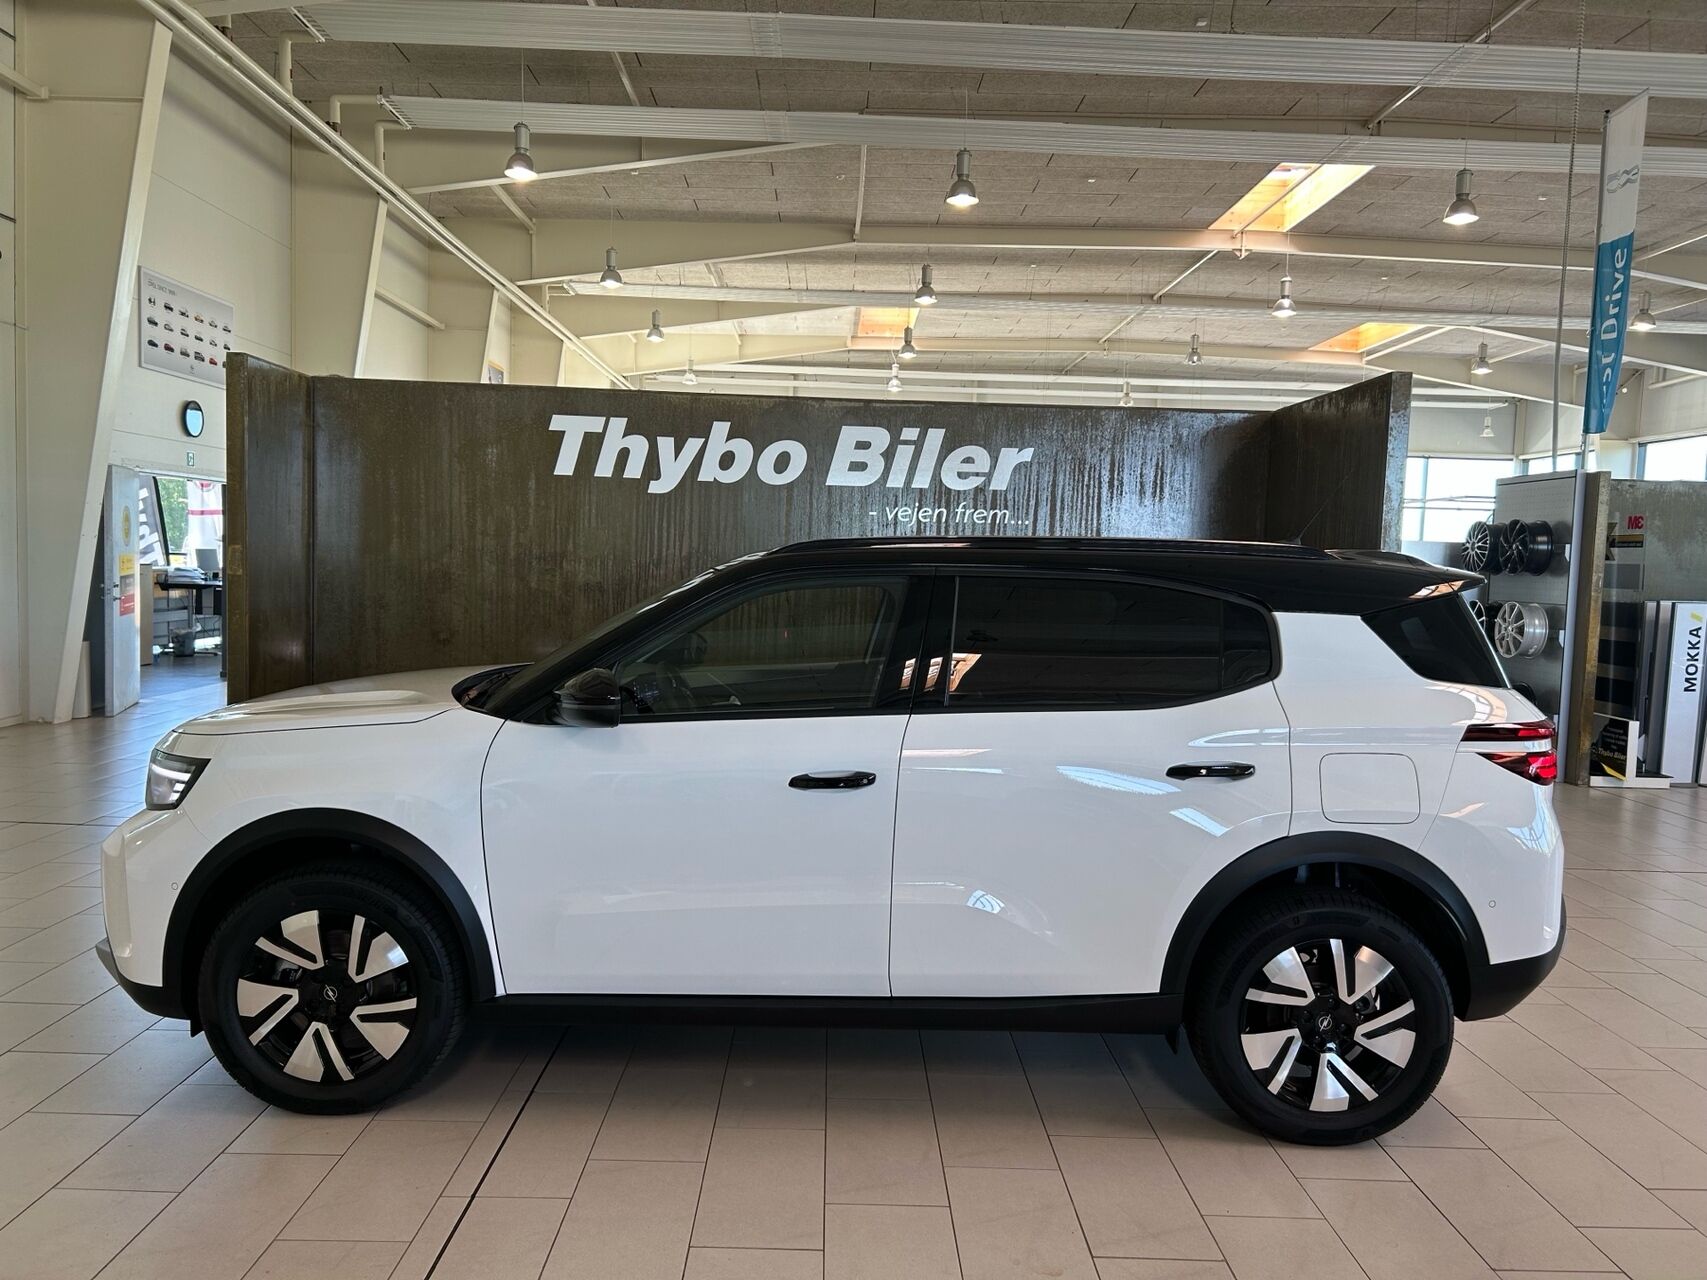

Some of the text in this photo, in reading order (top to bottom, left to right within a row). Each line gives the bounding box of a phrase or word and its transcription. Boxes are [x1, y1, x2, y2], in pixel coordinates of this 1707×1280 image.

[1601, 248, 1628, 341] Drive
[548, 414, 1035, 494] Thybo Biler
[886, 502, 947, 527] vejen
[955, 501, 1030, 525] frem...
[1683, 626, 1702, 692] MOKKA
